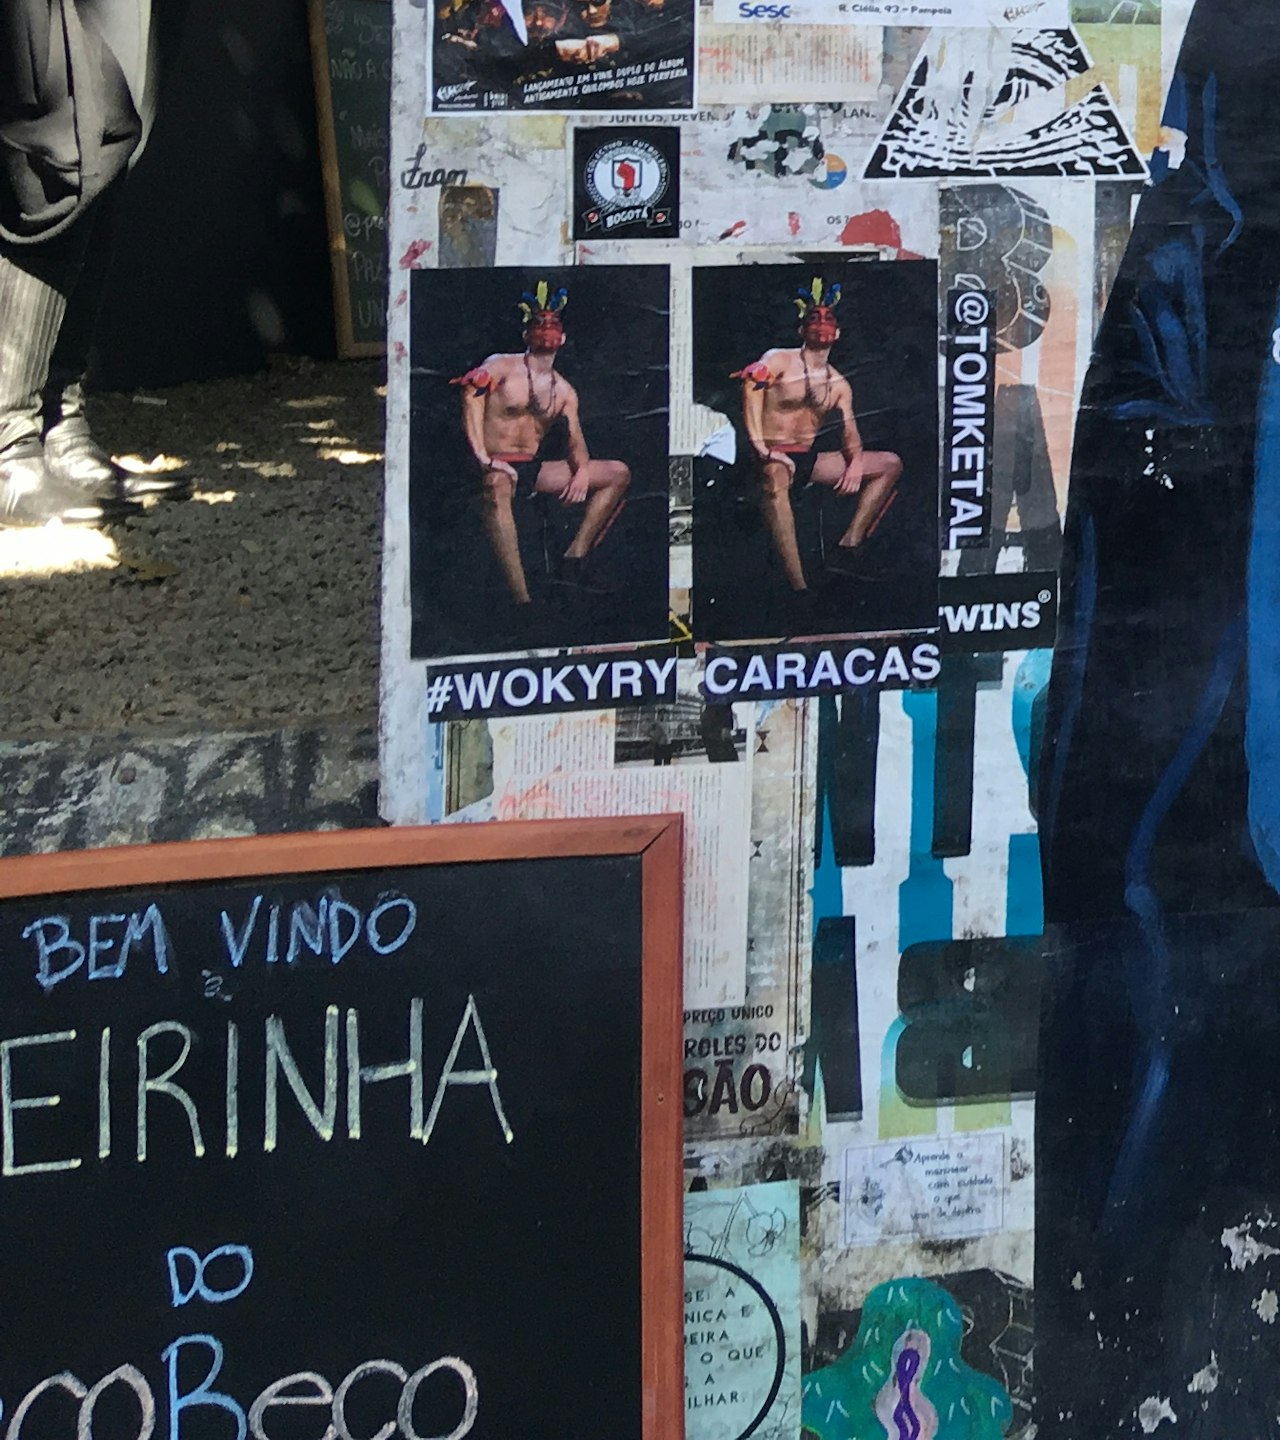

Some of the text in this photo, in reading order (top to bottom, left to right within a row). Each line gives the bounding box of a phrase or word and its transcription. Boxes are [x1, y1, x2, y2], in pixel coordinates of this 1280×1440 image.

[606, 206, 649, 229] BOGOTÁ
[427, 643, 941, 714] #WOKYRY CARACAS
[22, 893, 417, 988] BEM VINDO
[755, 1031, 782, 1054] DO
[0, 993, 513, 1176] EIRINHA
[168, 1243, 254, 1307] DO
[725, 1286, 736, 1299] A
[700, 1345, 765, 1365] O QUE
[704, 1373, 716, 1386] A
